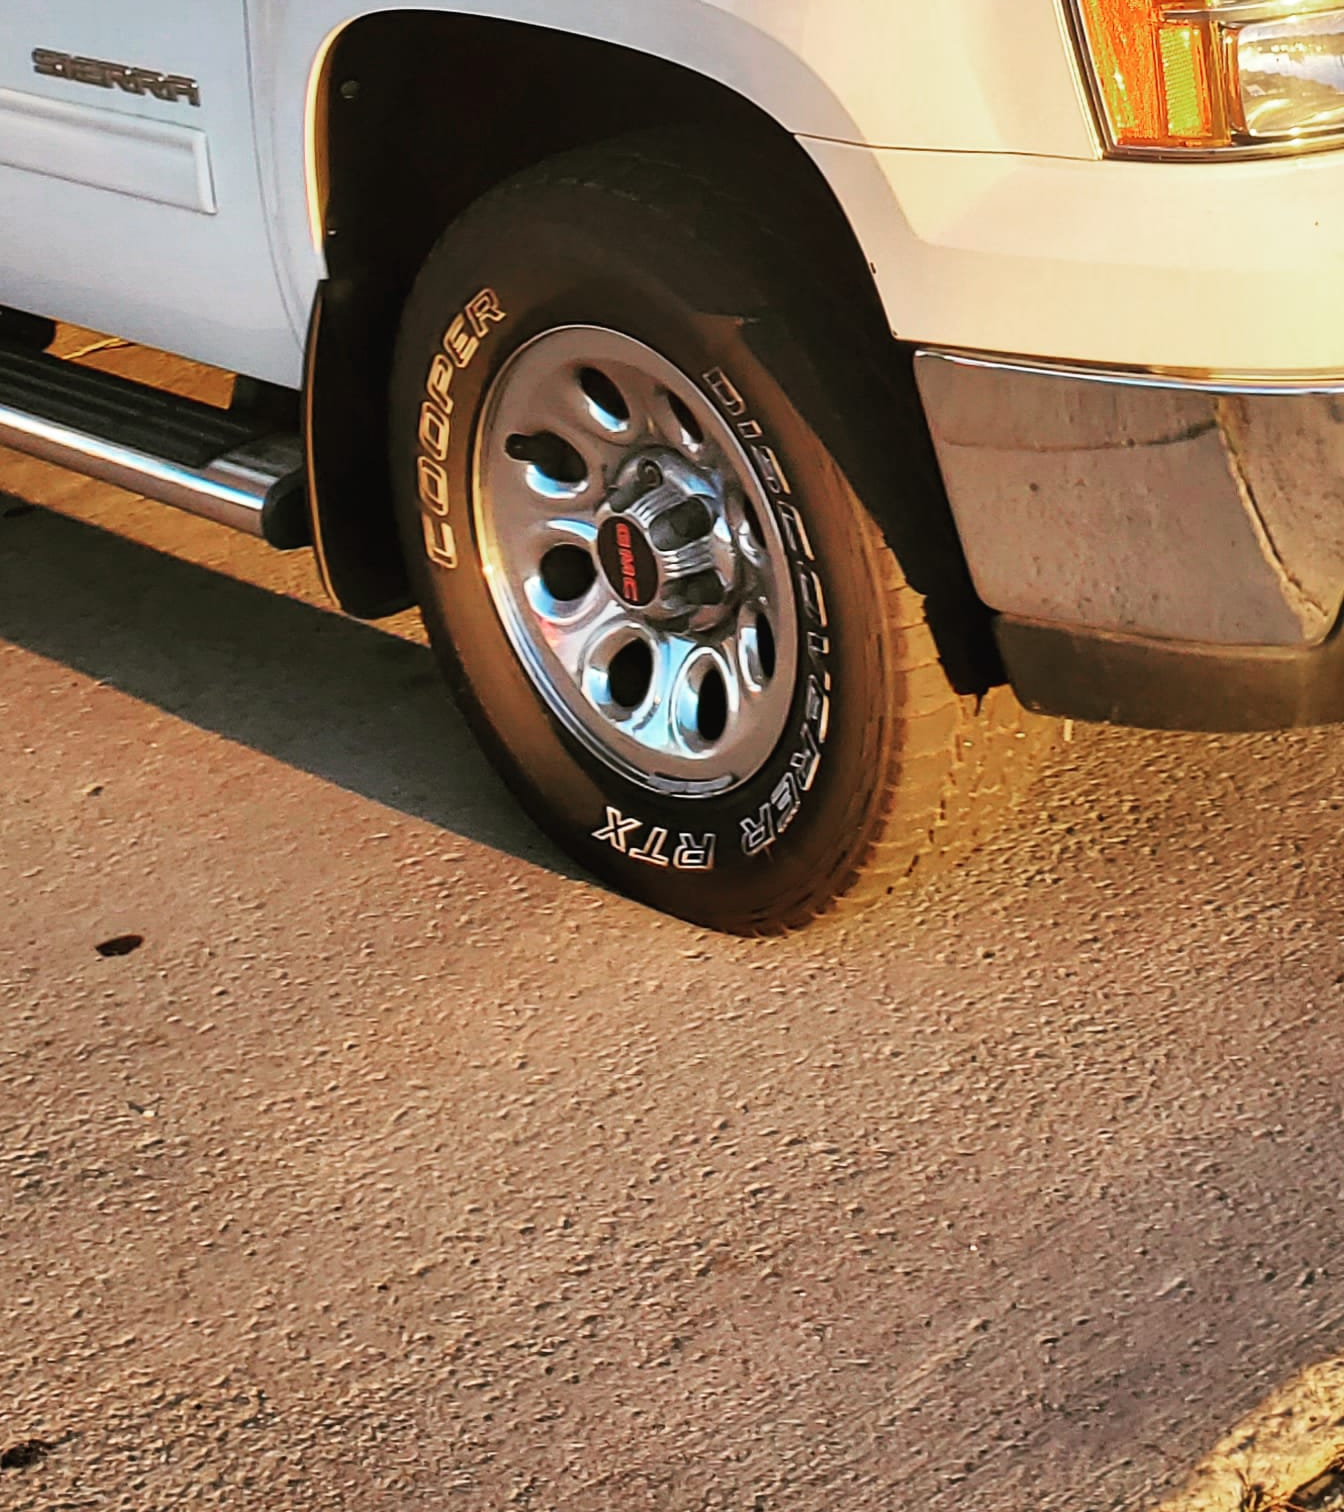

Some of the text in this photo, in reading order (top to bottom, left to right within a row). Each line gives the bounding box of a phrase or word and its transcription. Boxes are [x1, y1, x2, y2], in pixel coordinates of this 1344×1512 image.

[32, 48, 201, 107] SIERRA
[418, 288, 506, 569] COOPER
[592, 366, 831, 872] DISCOVERER RTX
[614, 522, 640, 602] GMC
